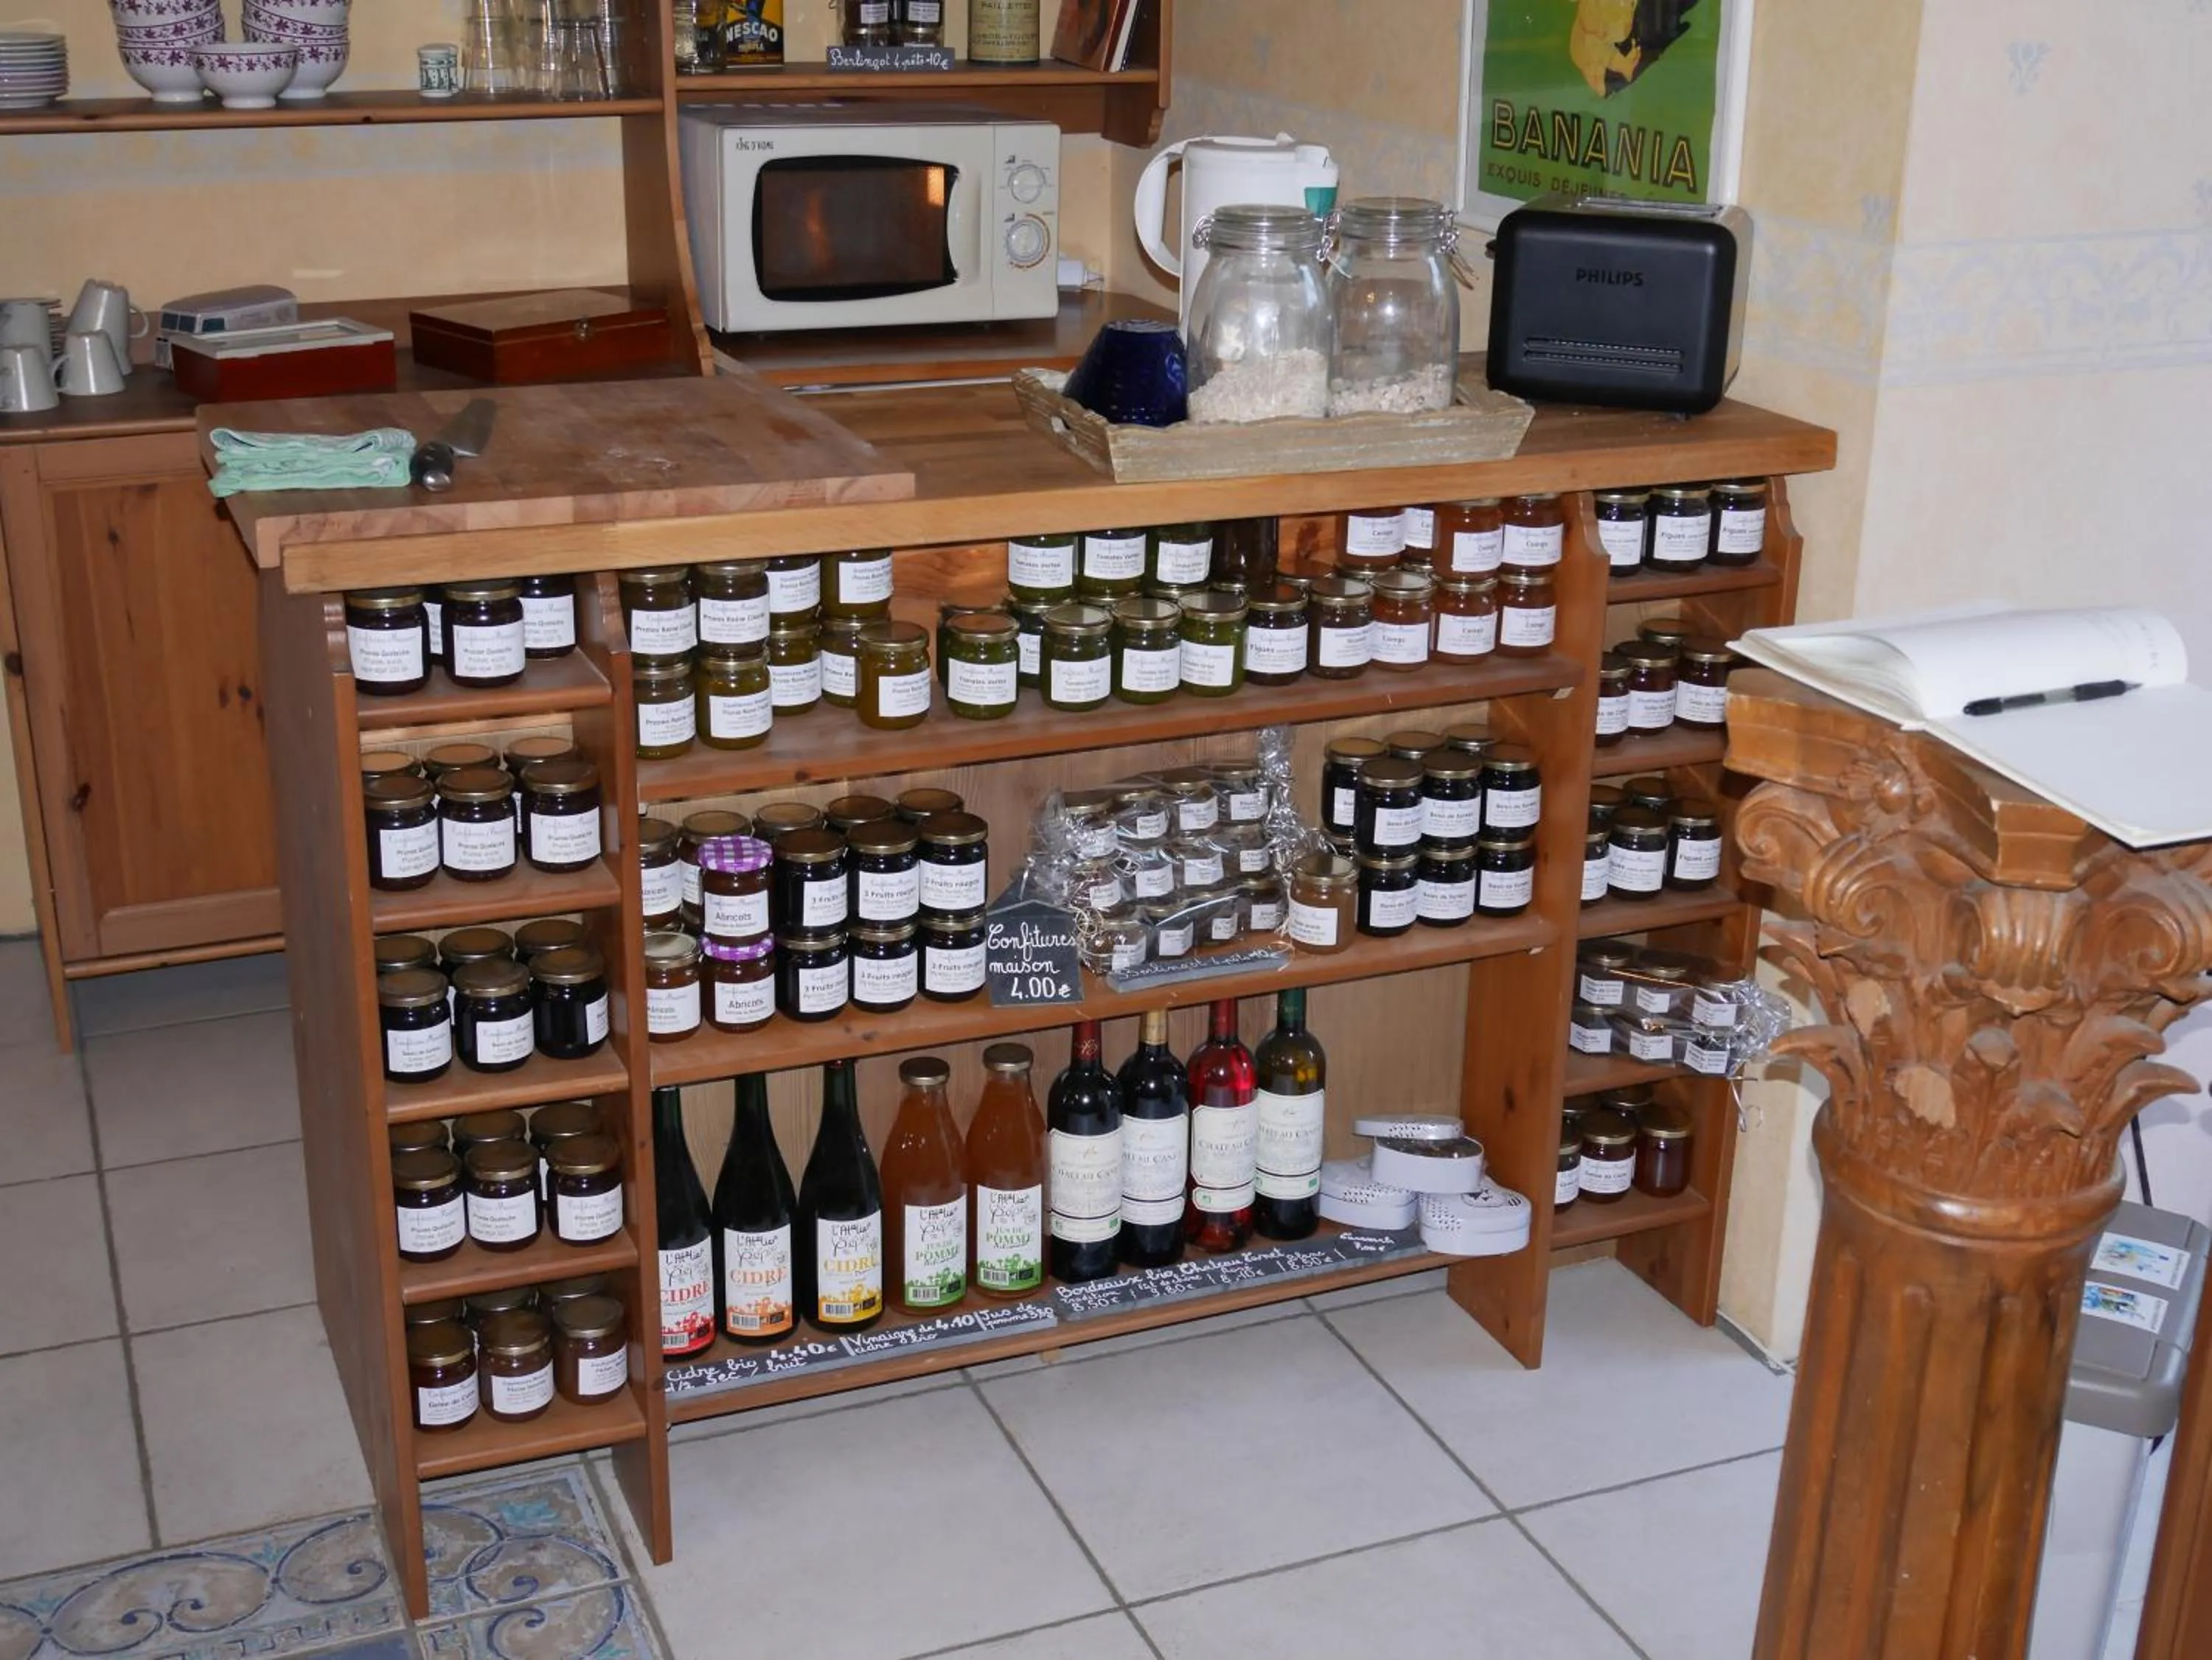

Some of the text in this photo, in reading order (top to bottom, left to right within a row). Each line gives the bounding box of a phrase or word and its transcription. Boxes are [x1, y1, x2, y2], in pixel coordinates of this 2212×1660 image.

[1491, 98, 1698, 194] BANANIA
[1486, 162, 1541, 188] EXQUIS
[1576, 268, 1644, 287] PHILIPS
[715, 911, 752, 921] Abricots
[987, 921, 1077, 961] Confitures
[989, 955, 1060, 974] maison
[728, 997, 764, 1010] Abricots
[824, 1255, 877, 1272] CIDRE
[730, 1266, 787, 1284] CIDRE
[1055, 1274, 1143, 1298] Bordeaux
[666, 1364, 720, 1381] Cidre
[726, 1358, 757, 1371] bio
[766, 1355, 808, 1372] brut
